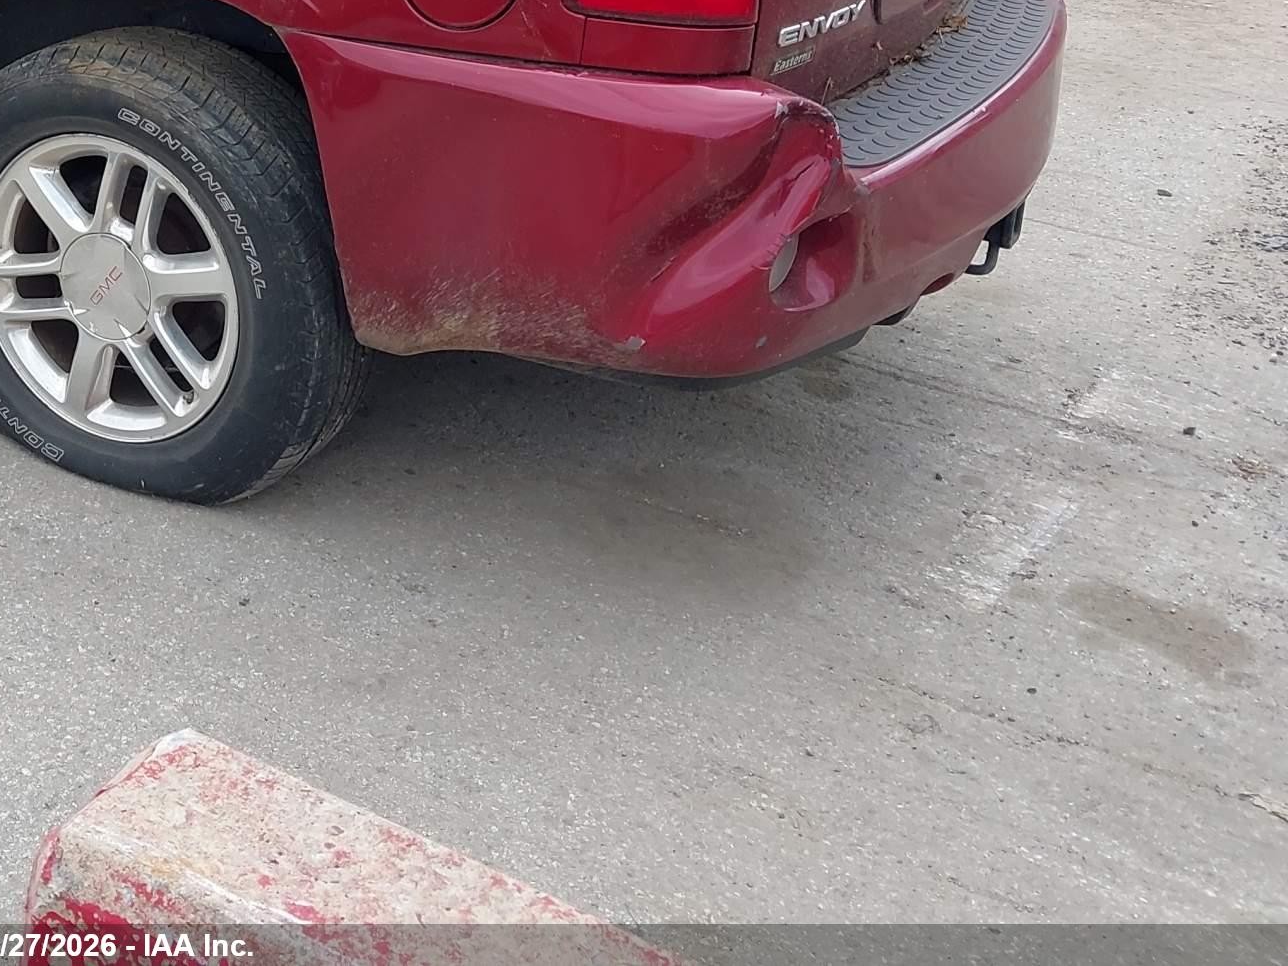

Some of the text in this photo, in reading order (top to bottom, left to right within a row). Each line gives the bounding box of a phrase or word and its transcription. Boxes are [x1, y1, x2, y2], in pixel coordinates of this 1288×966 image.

[778, 0, 867, 48] ENVOY
[117, 107, 267, 300] CONTINENTAL
[90, 265, 123, 305] GMC
